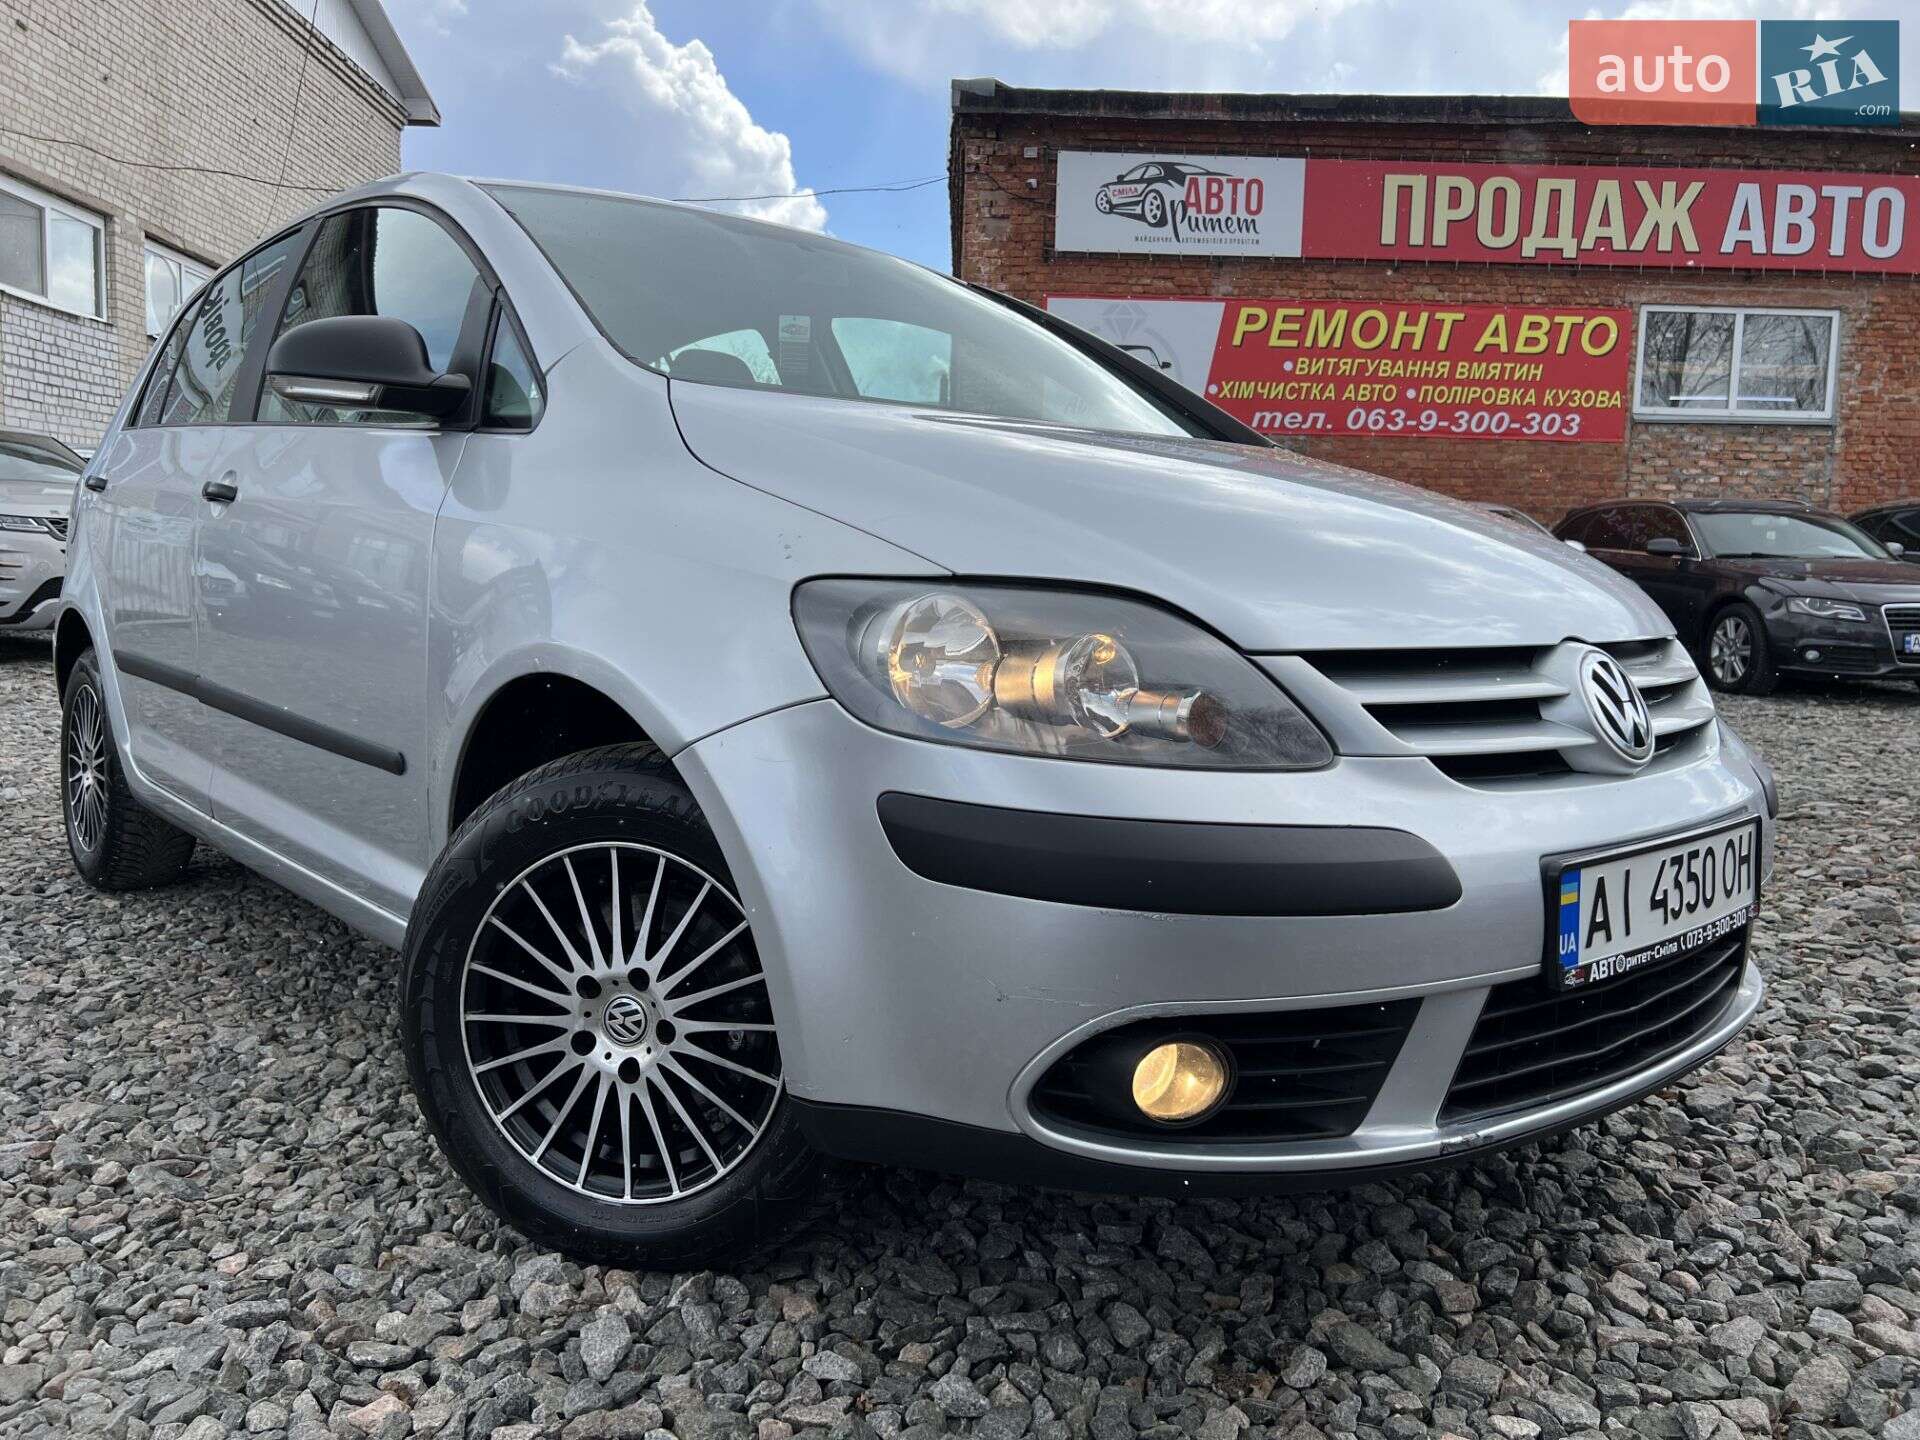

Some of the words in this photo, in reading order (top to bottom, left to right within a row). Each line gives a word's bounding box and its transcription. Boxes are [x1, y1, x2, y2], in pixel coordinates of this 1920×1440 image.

[1184, 176, 1264, 217] АВТО
[1380, 174, 1706, 260] ПРОДАЖ
[1719, 182, 1906, 259] АВТО
[1232, 307, 1466, 352] РЕМОНТ
[1473, 314, 1619, 357] АВТО
[1295, 357, 1450, 379] ВИТЯГУВАННЯ
[1455, 362, 1544, 382] ВМЯТИН
[1219, 380, 1336, 401] ХІМЧИСТКА
[1342, 383, 1398, 402] АВТО
[1418, 385, 1536, 406] ПОЛІРОВКА
[1543, 388, 1622, 408] КУЗОВА
[1251, 410, 1333, 430] тел.
[1346, 407, 1581, 436] 063-9-300-303
[1650, 845, 1716, 925] 4350
[1723, 830, 1753, 899] OH
[1559, 932, 1577, 955] UA
[1686, 909, 1747, 948] 073-9-300-300
